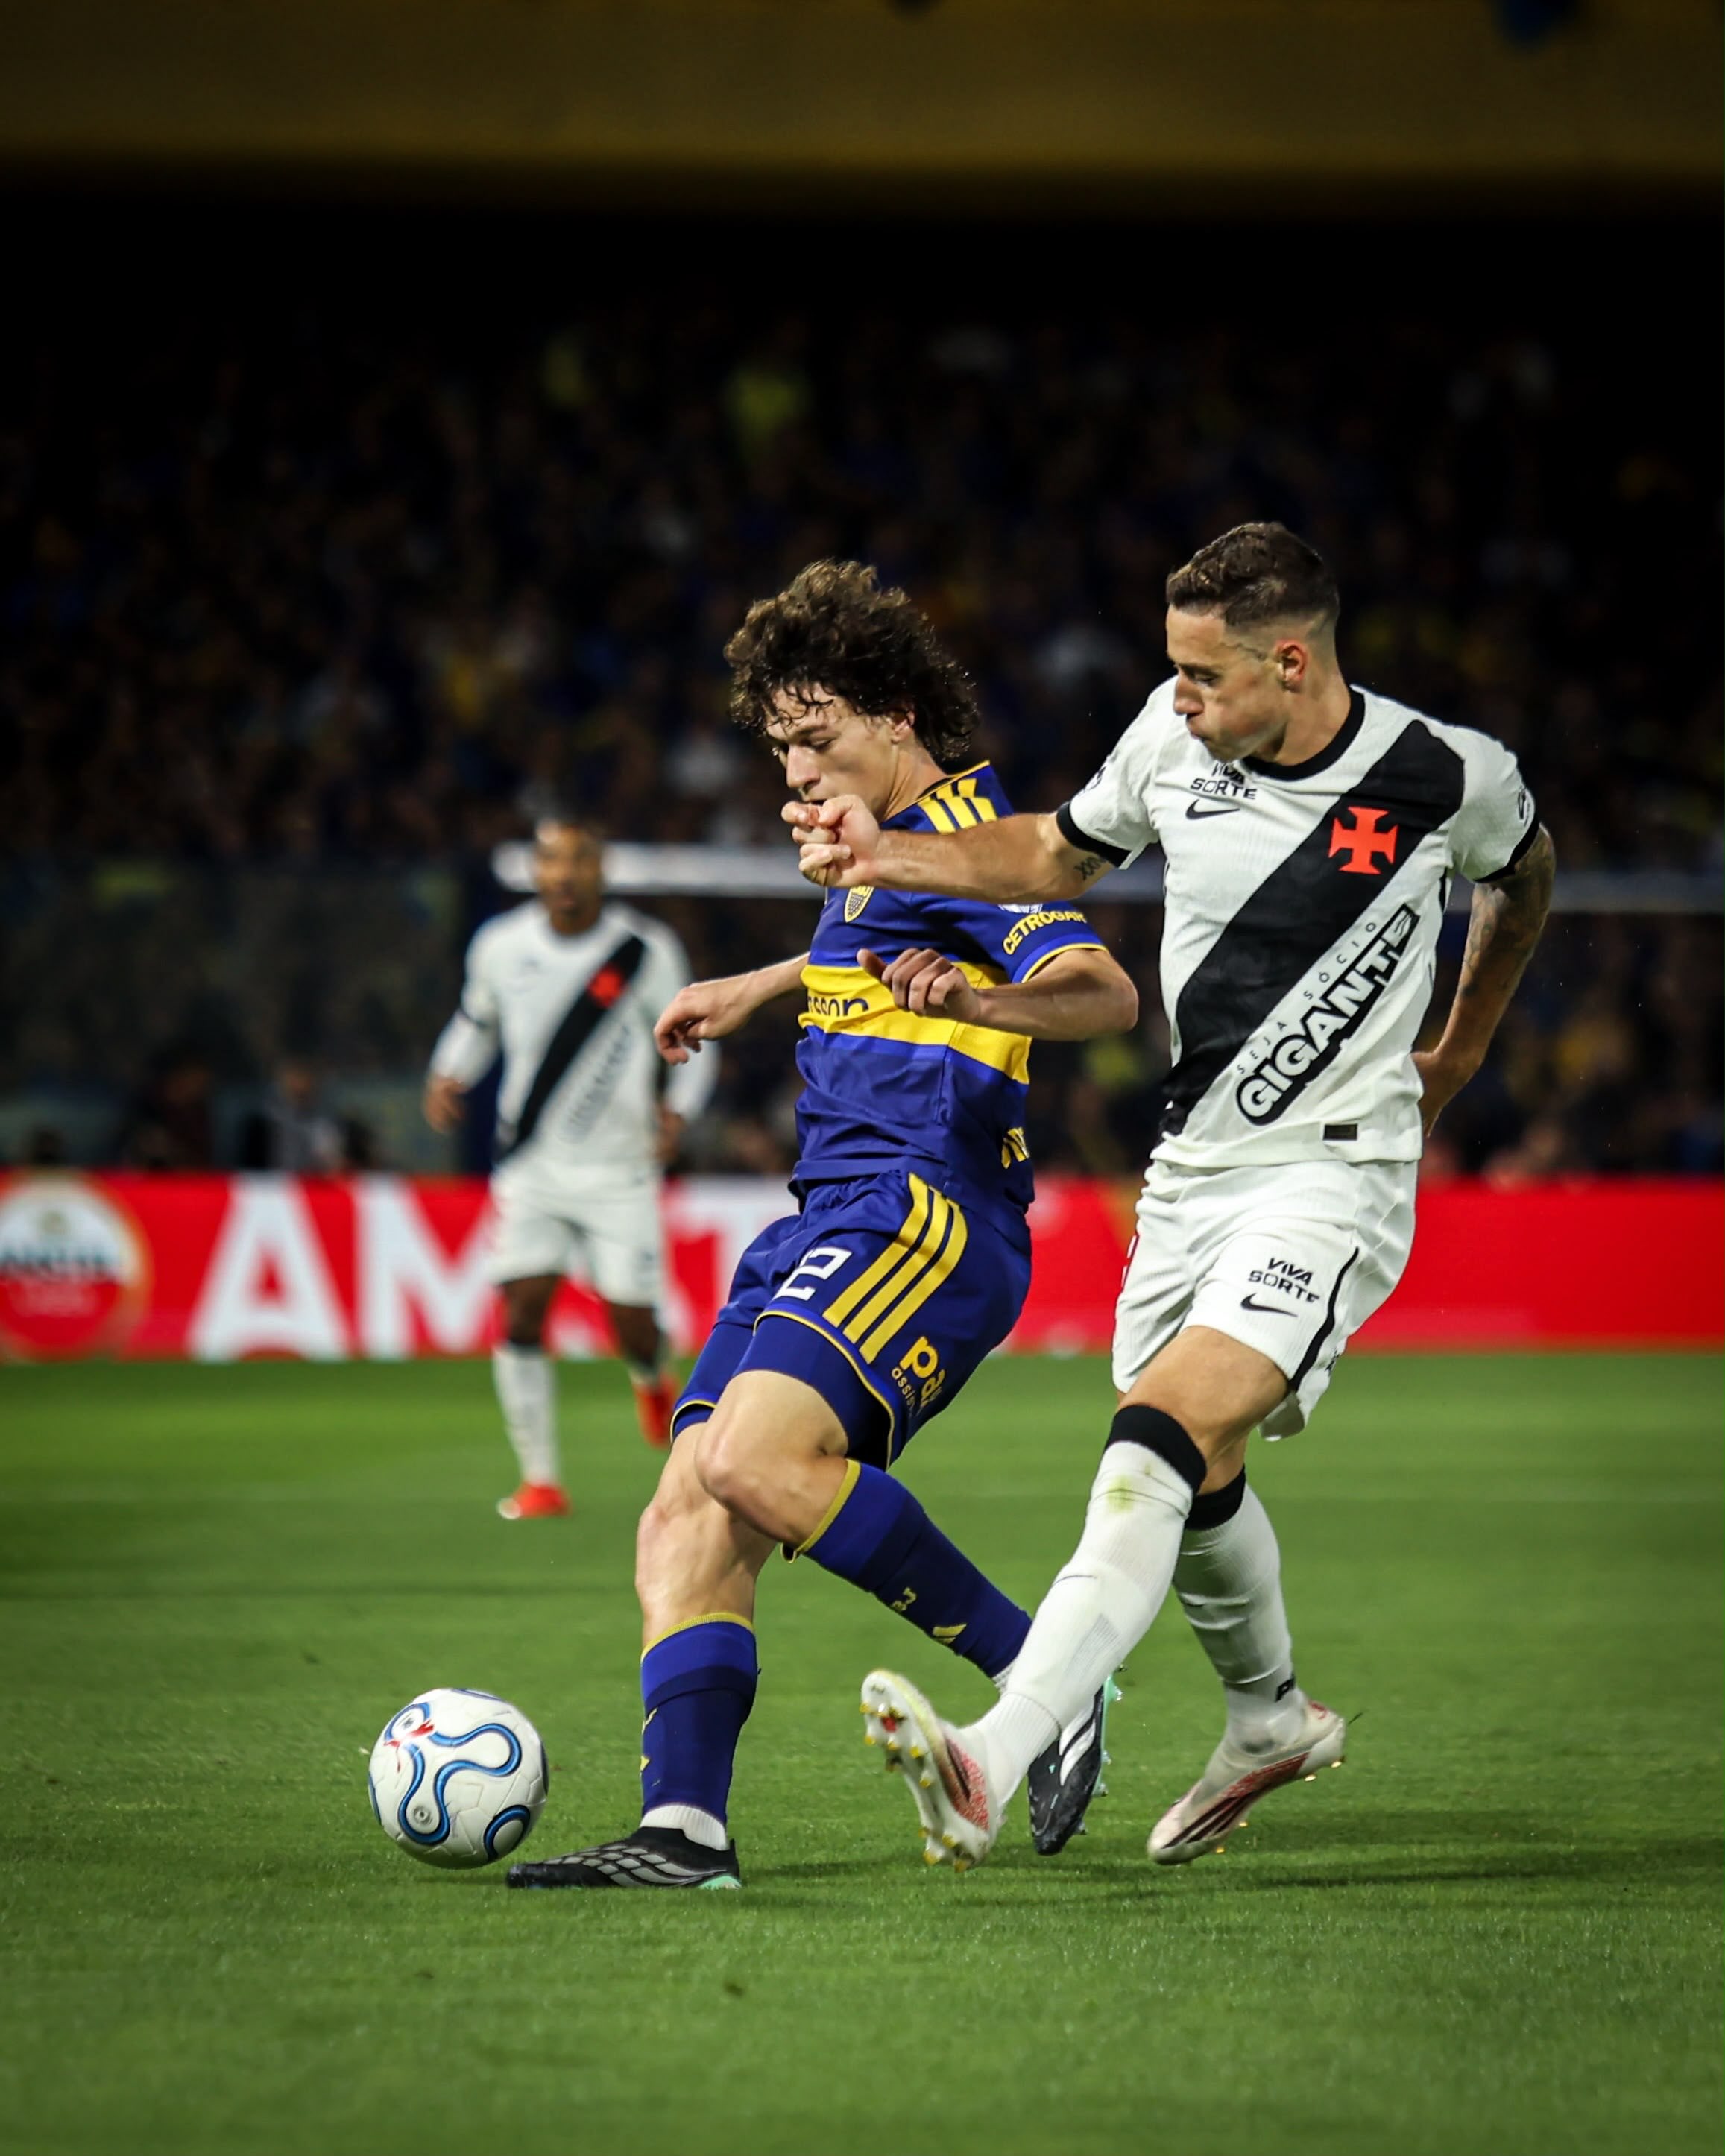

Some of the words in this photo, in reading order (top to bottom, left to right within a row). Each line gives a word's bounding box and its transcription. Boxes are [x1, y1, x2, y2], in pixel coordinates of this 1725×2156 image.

[1190, 778, 1258, 800] SORTE
[1003, 911, 1088, 955] CETROGAR
[1237, 1021, 1288, 1074] SEJA
[1303, 921, 1378, 1001] SÓCIO
[1237, 904, 1418, 1124] GIGANTE
[772, 1246, 854, 1301] 2
[1248, 1270, 1320, 1303] SORTE
[1267, 1257, 1314, 1286] VIVA
